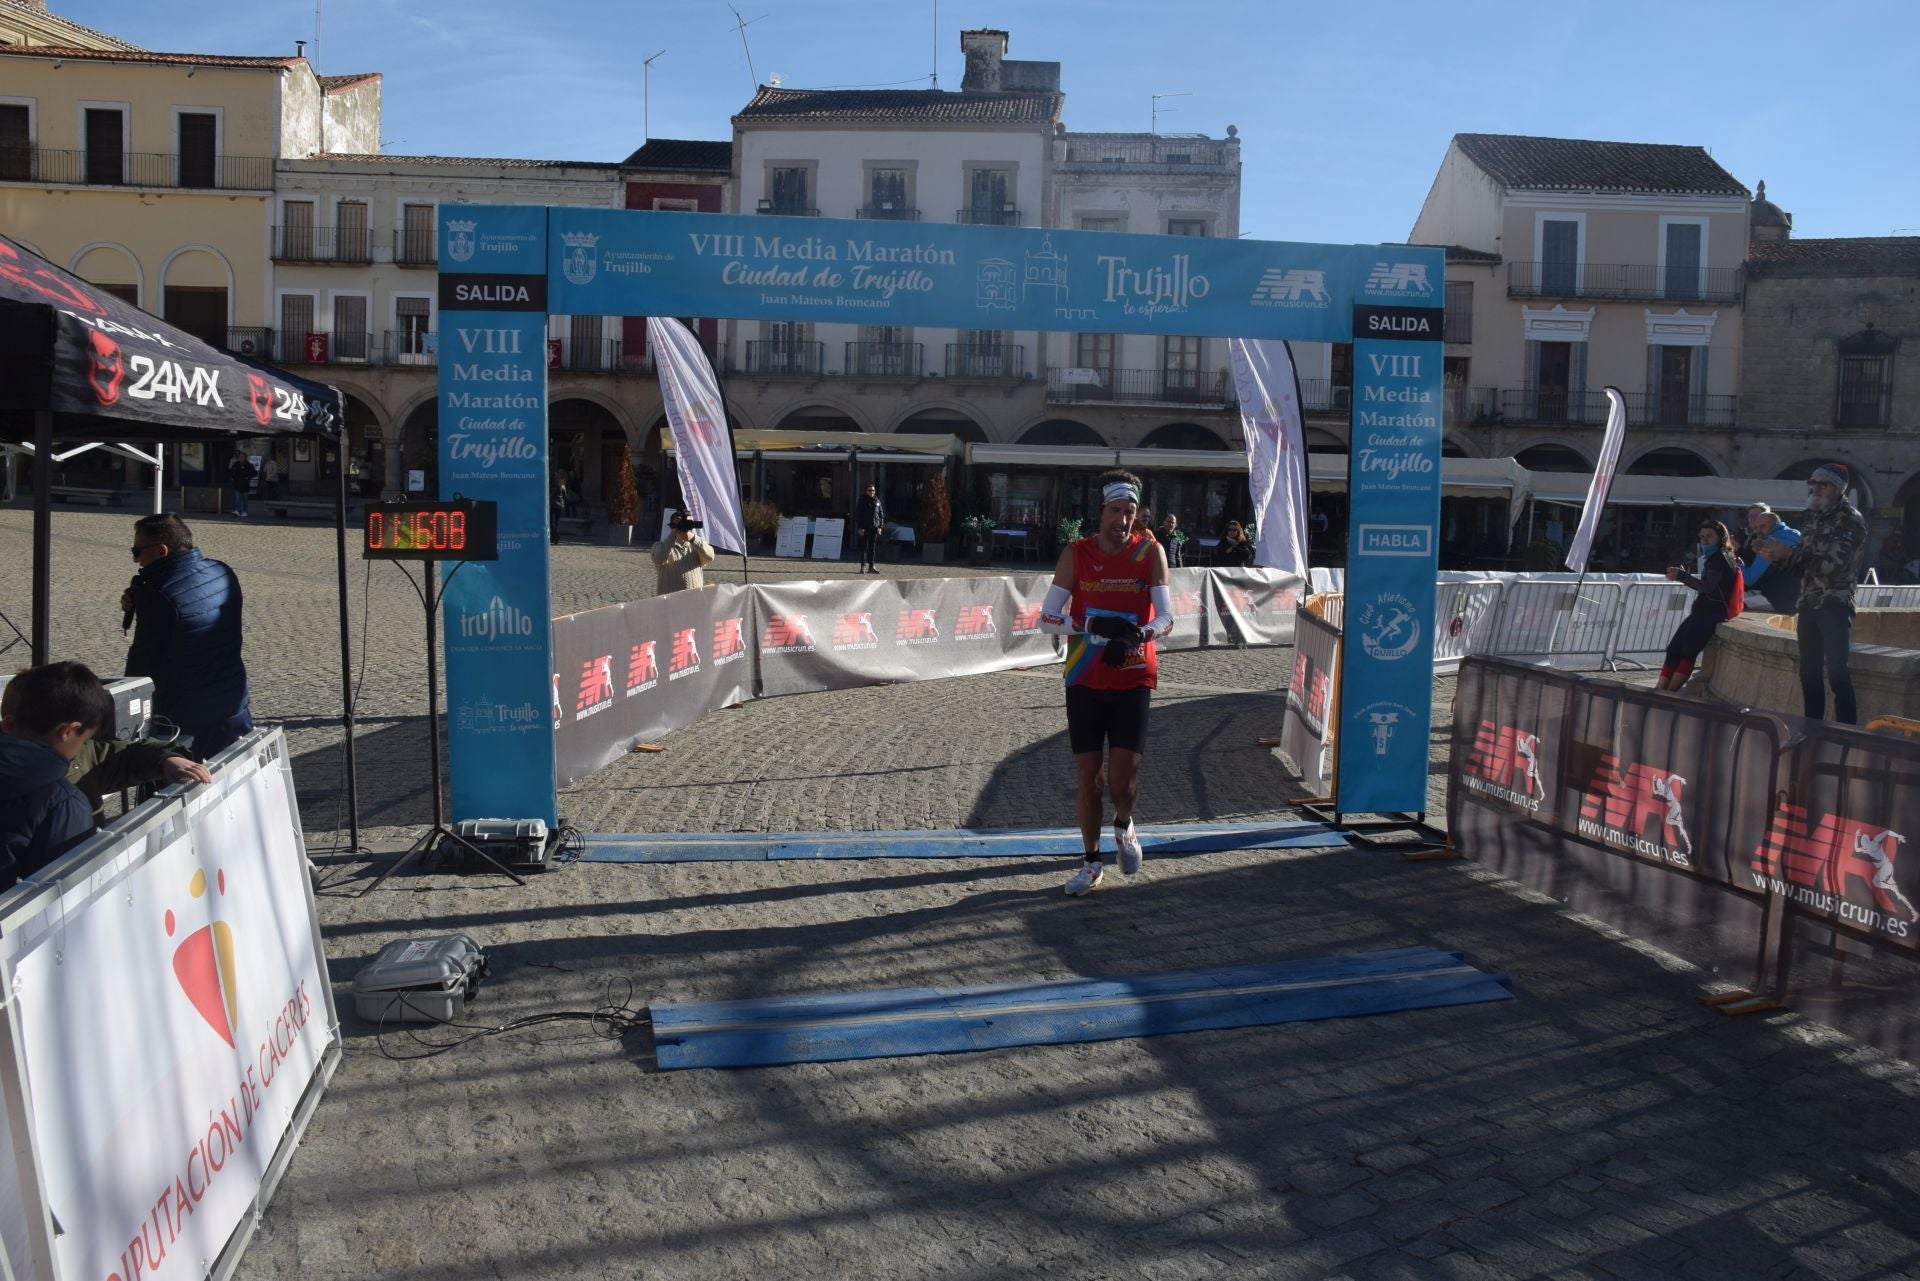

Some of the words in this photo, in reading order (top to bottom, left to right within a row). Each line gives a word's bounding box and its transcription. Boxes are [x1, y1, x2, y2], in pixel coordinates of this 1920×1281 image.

[479, 233, 527, 242] Ayuntamiento
[479, 242, 519, 254] Trujillo
[604, 249, 664, 262] Ayuntamiento
[665, 252, 675, 261] de
[688, 233, 745, 256] VIII
[754, 236, 837, 261] Media
[846, 239, 955, 265] Maratón
[603, 261, 651, 276] Trujillo
[722, 261, 809, 287] Ciudad
[813, 266, 845, 288] de
[850, 265, 935, 299] Trujillo
[1097, 254, 1210, 308] Trujillo
[455, 283, 531, 303] SALIDA
[760, 293, 788, 305] Juan
[791, 294, 833, 306] Mateos
[836, 295, 891, 309] Broncano
[1364, 288, 1431, 298] www.musicrun.es
[1123, 297, 1136, 315] te
[1250, 299, 1329, 310] www.musicrun.es
[1368, 315, 1431, 333] SALIDA
[456, 328, 522, 354] VIII
[452, 363, 534, 382] Media
[1368, 354, 1422, 378] VIII
[128, 355, 225, 408] 24MX
[447, 391, 540, 410] Maratón
[1363, 385, 1431, 404] Media
[459, 416, 507, 431] Ciudad
[508, 418, 526, 431] de
[1359, 410, 1436, 428] Maratón
[1368, 432, 1408, 446] Ciudad
[1409, 434, 1425, 447] de
[447, 433, 537, 469] Trujillo
[1358, 449, 1434, 481] Trujillo
[1369, 533, 1421, 548] HABLA
[461, 595, 533, 642] trujillo
[1359, 602, 1375, 625] Club
[761, 644, 815, 654] www.musicrun.es
[495, 703, 540, 723] Trujillo
[1462, 774, 1539, 811] www.musicrun.es
[1578, 817, 1689, 867] www.musicrun.es
[1752, 872, 1909, 938] www.musicrun.es
[239, 1063, 261, 1129] DE
[259, 978, 311, 1089] CÁCERES
